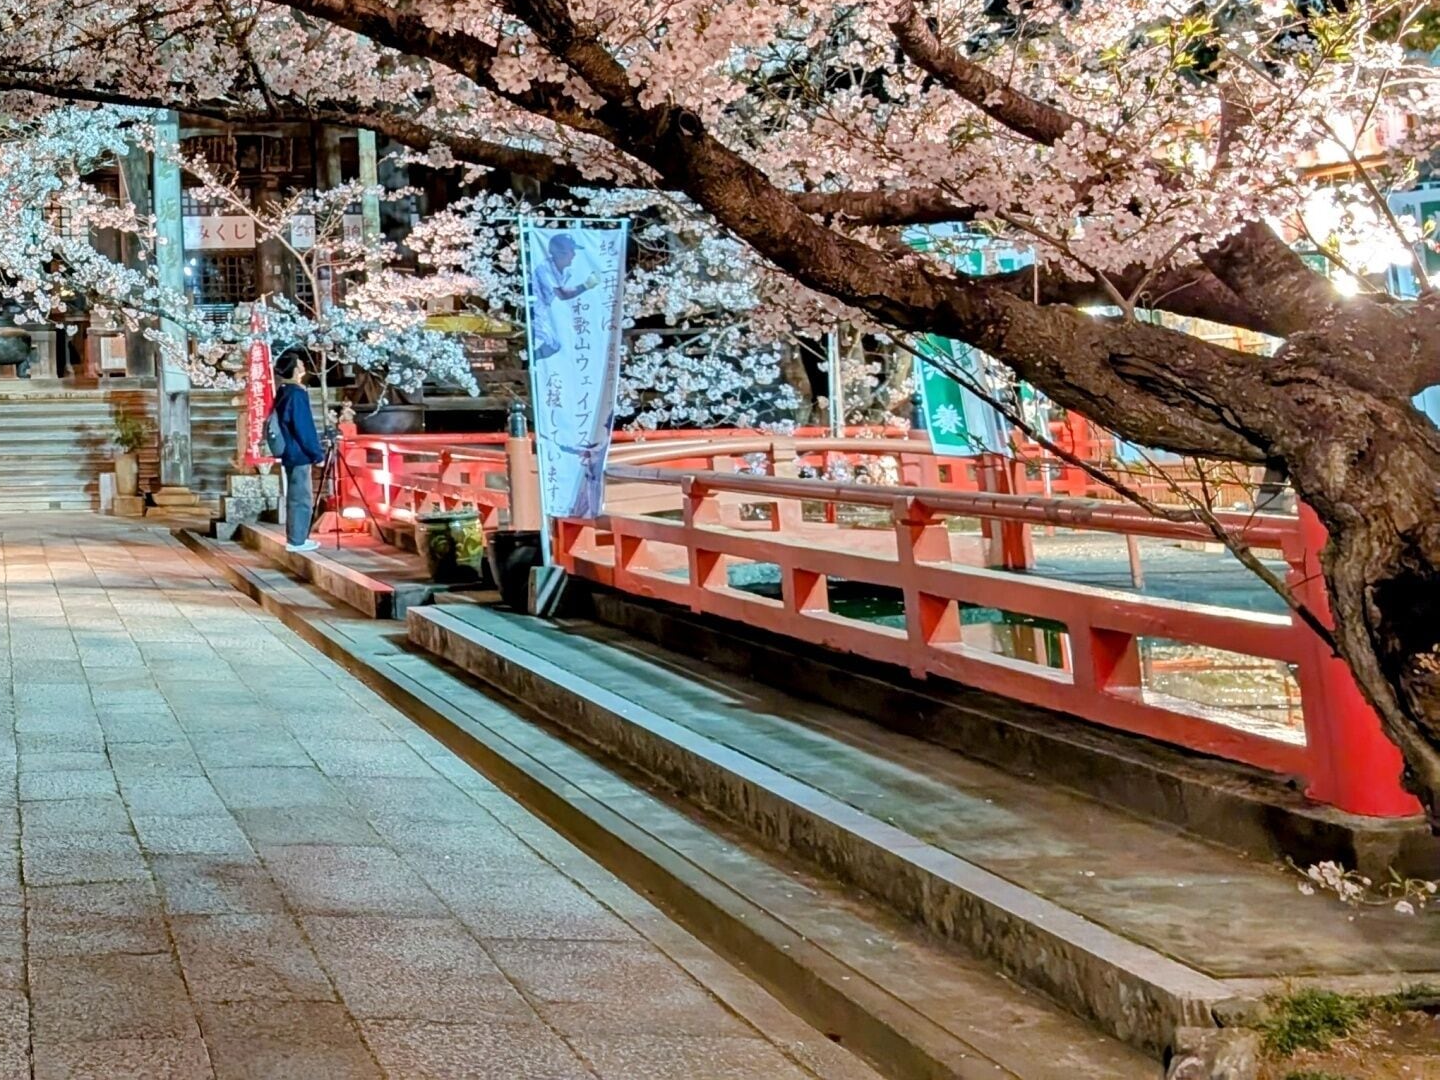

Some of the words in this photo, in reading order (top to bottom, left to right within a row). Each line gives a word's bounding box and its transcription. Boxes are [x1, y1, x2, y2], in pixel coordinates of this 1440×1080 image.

[186, 223, 247, 241] みくじ
[546, 373, 563, 501] 応援しています
